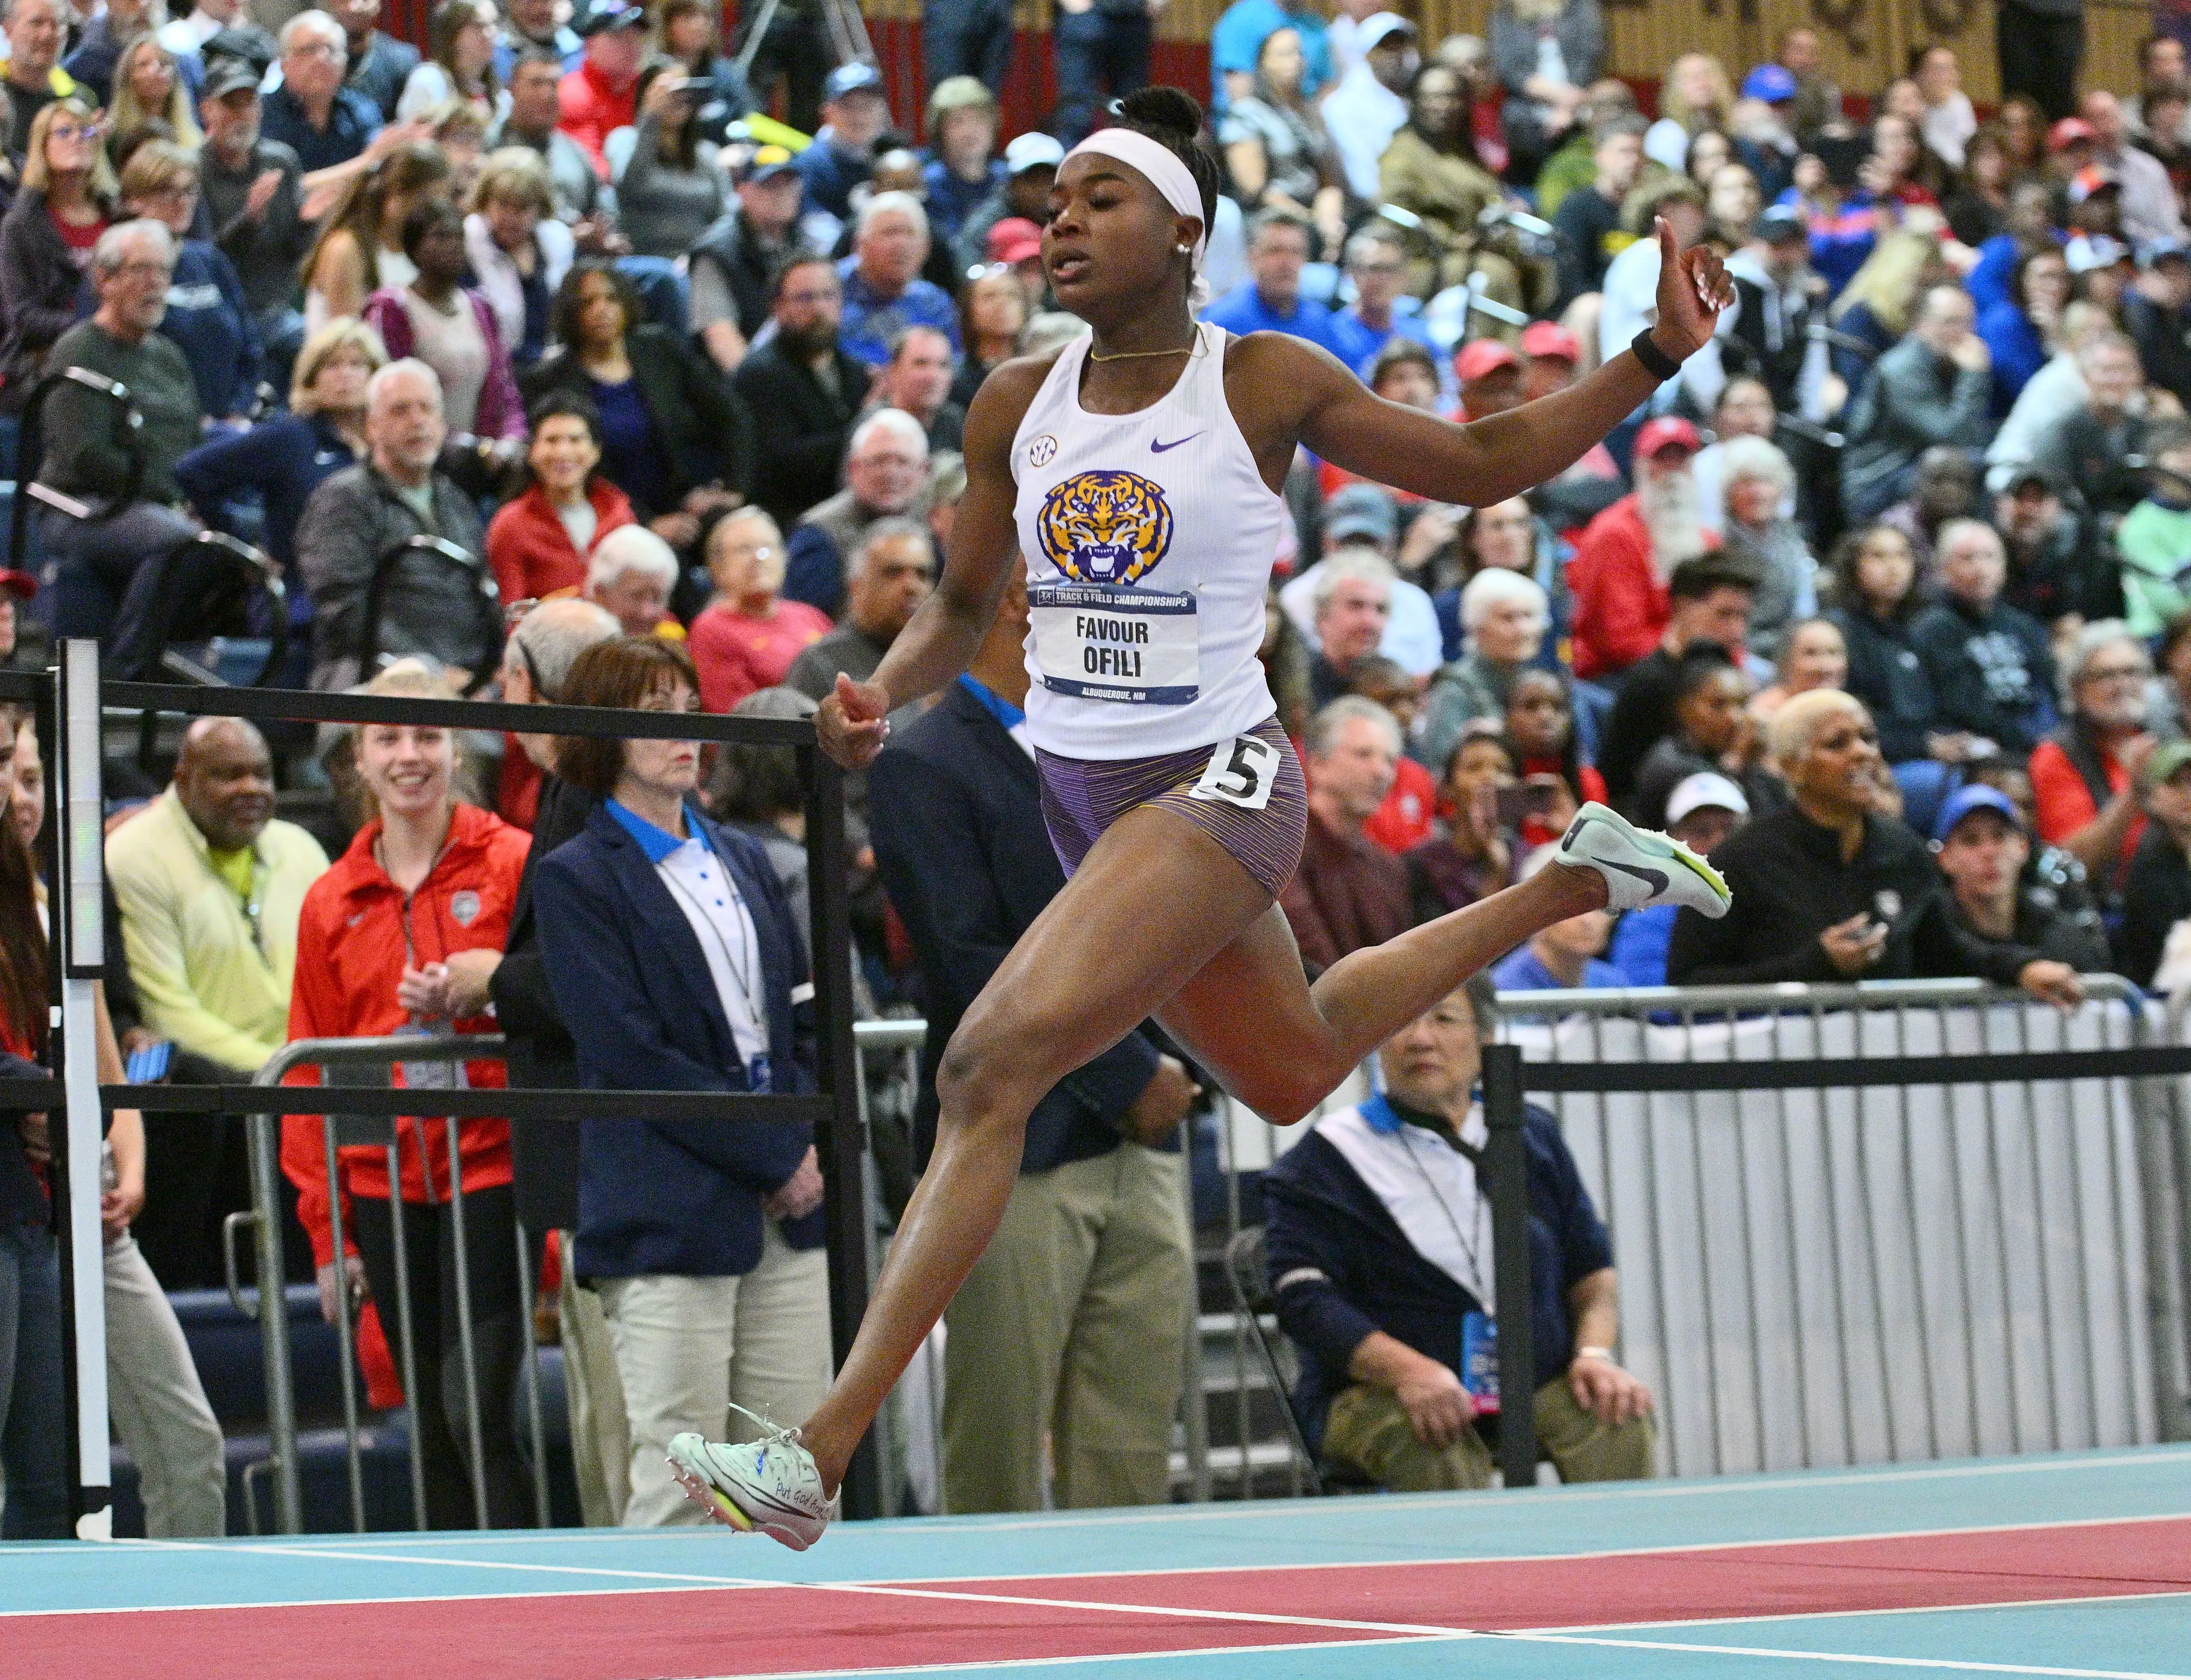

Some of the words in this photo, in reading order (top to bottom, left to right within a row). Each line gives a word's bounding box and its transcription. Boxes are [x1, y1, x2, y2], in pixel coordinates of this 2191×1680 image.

[1056, 592, 1082, 601] TRACK
[1091, 593, 1112, 603] FIELD
[1114, 594, 1187, 607] CHAMPIONSHIPS
[1077, 616, 1149, 643] FAVOUR
[1084, 646, 1141, 677] OFILI
[1082, 687, 1131, 701] ALBUQUERQUE,
[1133, 692, 1146, 701] NM
[1215, 738, 1268, 799] 5
[776, 1483, 791, 1499] Put
